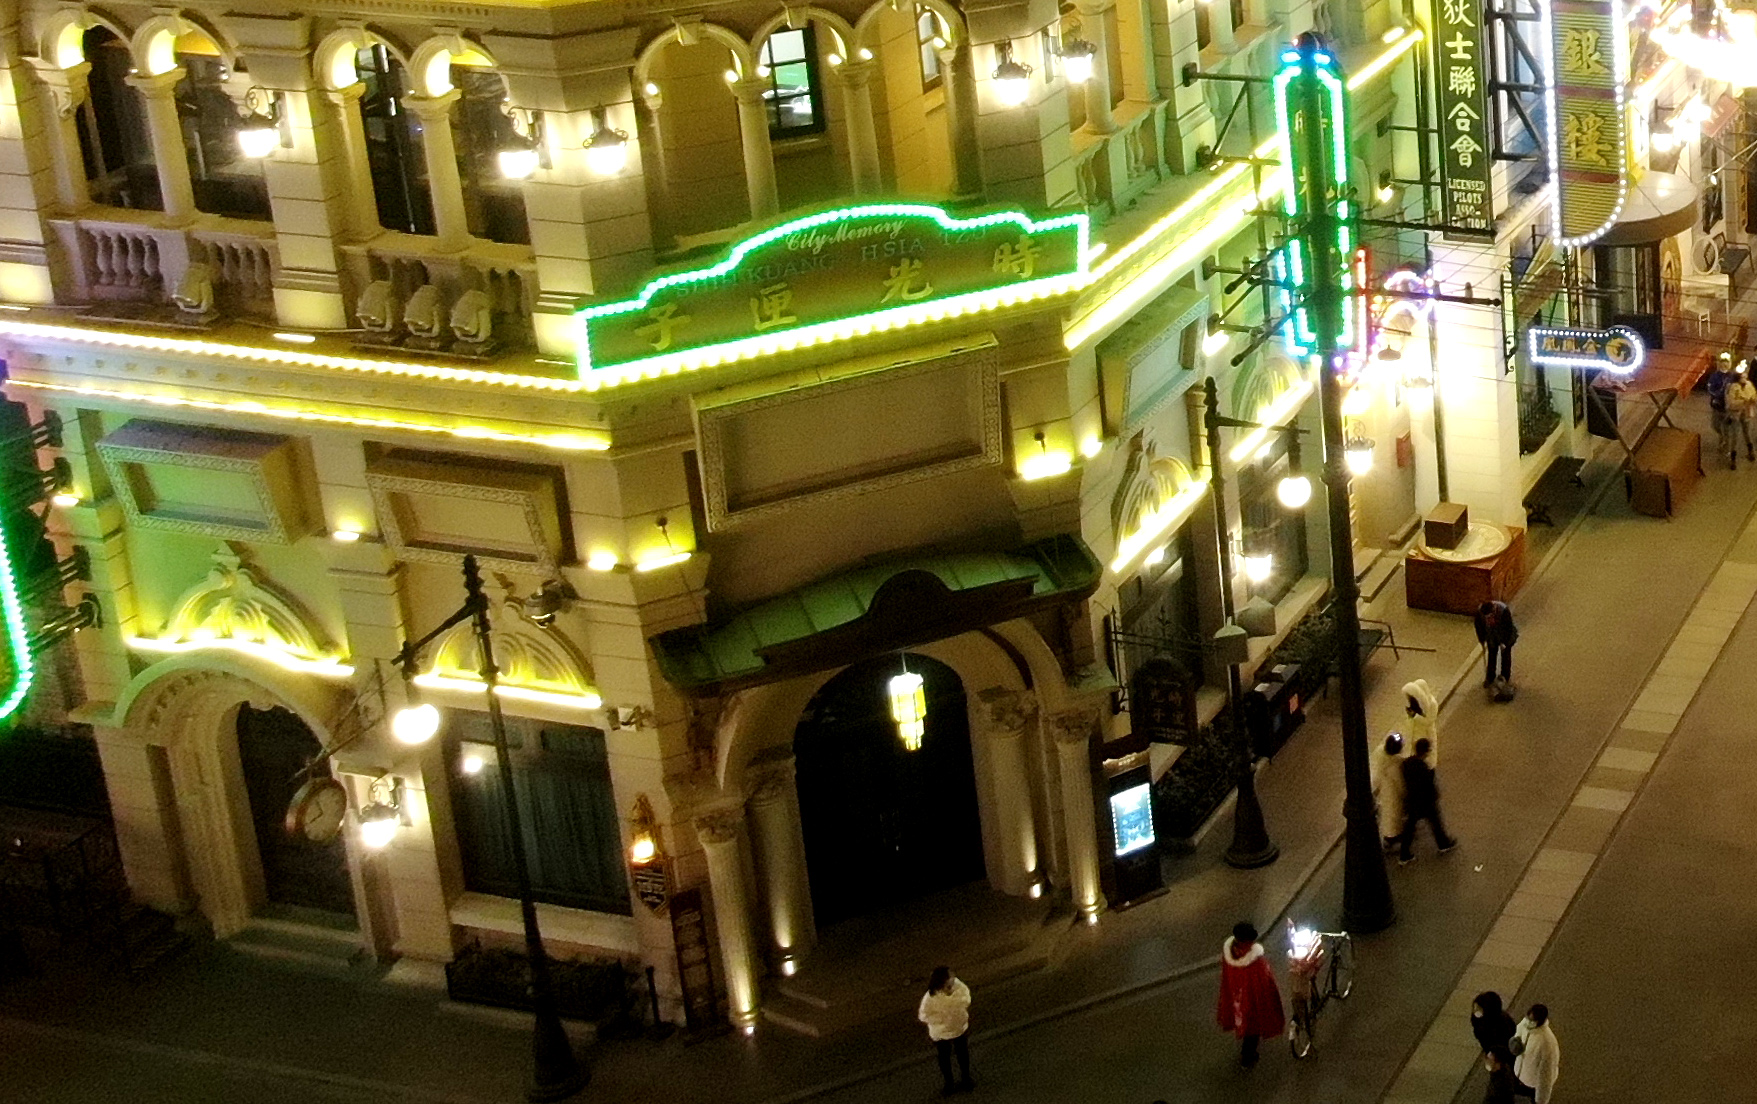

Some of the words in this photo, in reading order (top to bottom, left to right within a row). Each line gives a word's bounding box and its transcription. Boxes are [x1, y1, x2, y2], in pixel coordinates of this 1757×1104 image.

[1448, 177, 1486, 191] LICENSED
[1453, 191, 1483, 204] PILOTS
[746, 253, 837, 284] KUANG
[861, 239, 926, 262] HSIA
